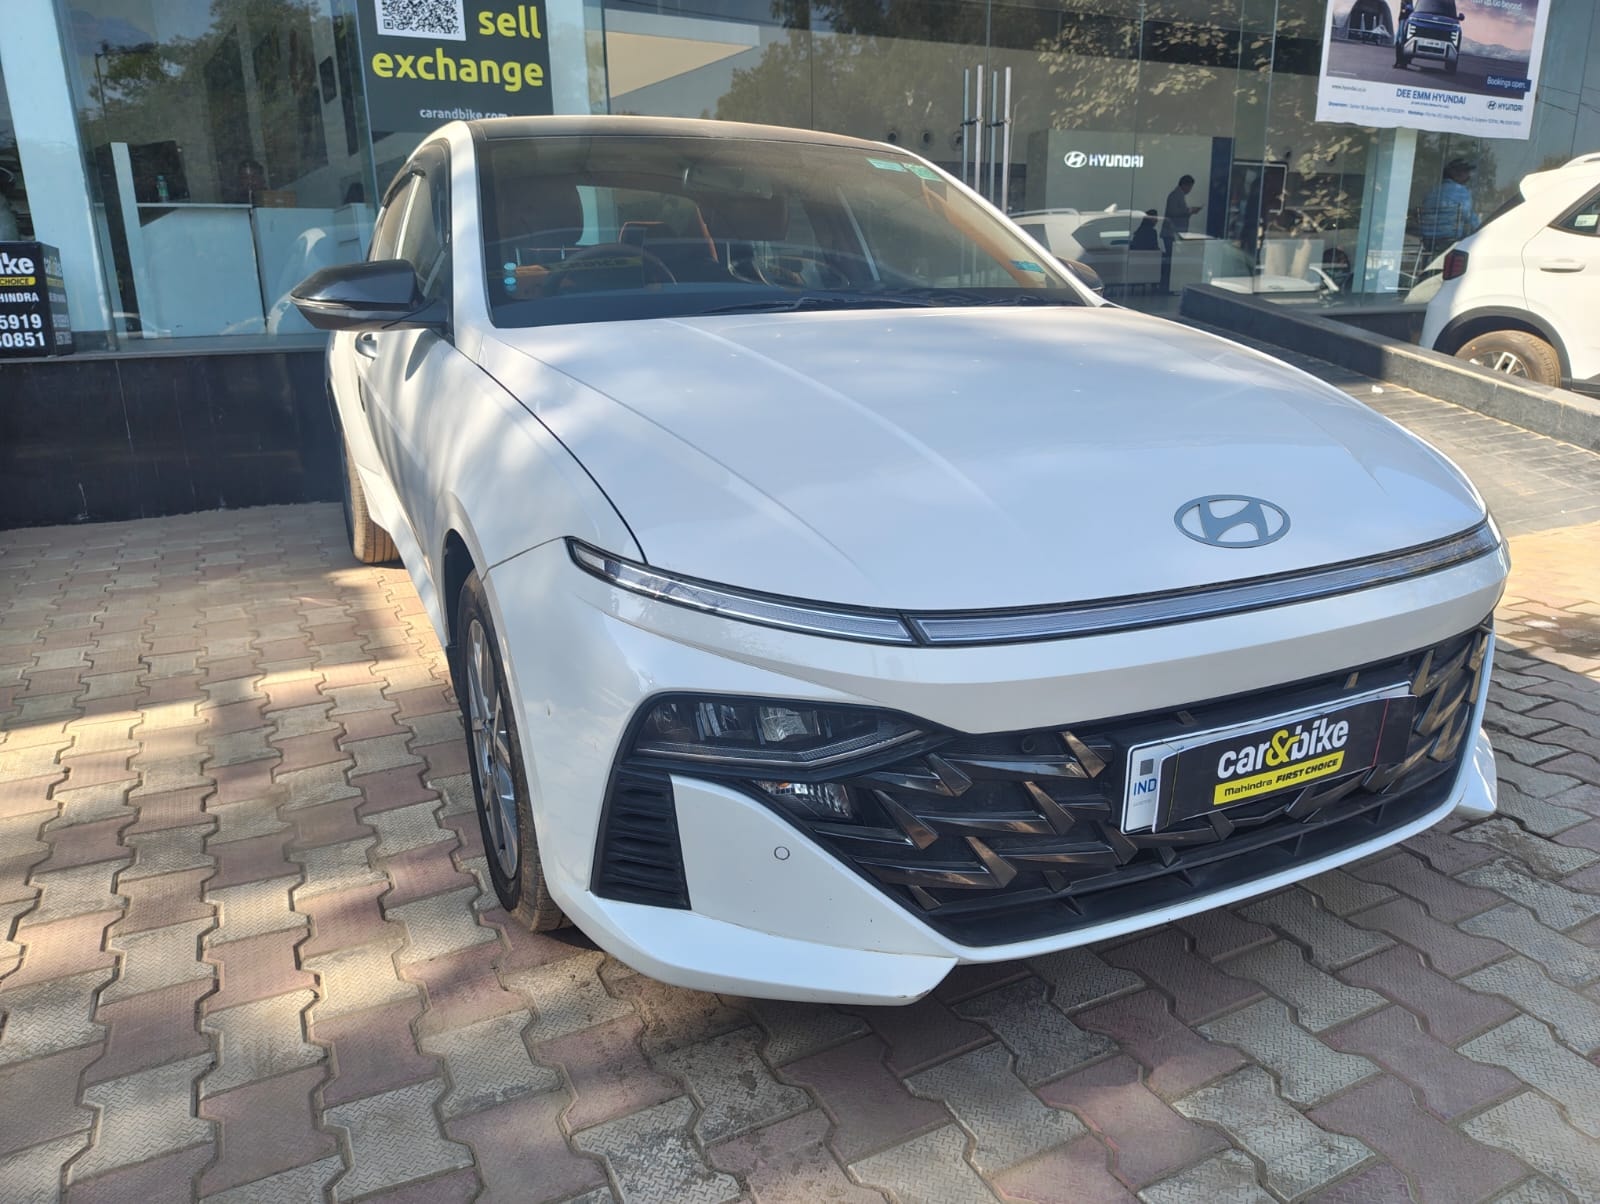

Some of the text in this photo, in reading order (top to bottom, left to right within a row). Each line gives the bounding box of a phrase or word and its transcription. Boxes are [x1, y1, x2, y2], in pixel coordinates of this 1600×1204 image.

[478, 5, 542, 39] sell
[371, 48, 545, 93] exchange
[1487, 76, 1511, 88] Bookings
[1396, 88, 1411, 99] DEE
[1412, 90, 1431, 101] EMM
[1432, 92, 1467, 105] HYUNDAI
[419, 107, 508, 120] carandbikecom
[1498, 104, 1523, 112] HYUNDAI
[1089, 154, 1144, 168] HYUNDAI
[0, 332, 45, 347] 0851
[1217, 717, 1349, 779] car&bike
[1224, 757, 1339, 797] Mahindra FIRST CHOICE
[1133, 778, 1158, 796] IND
